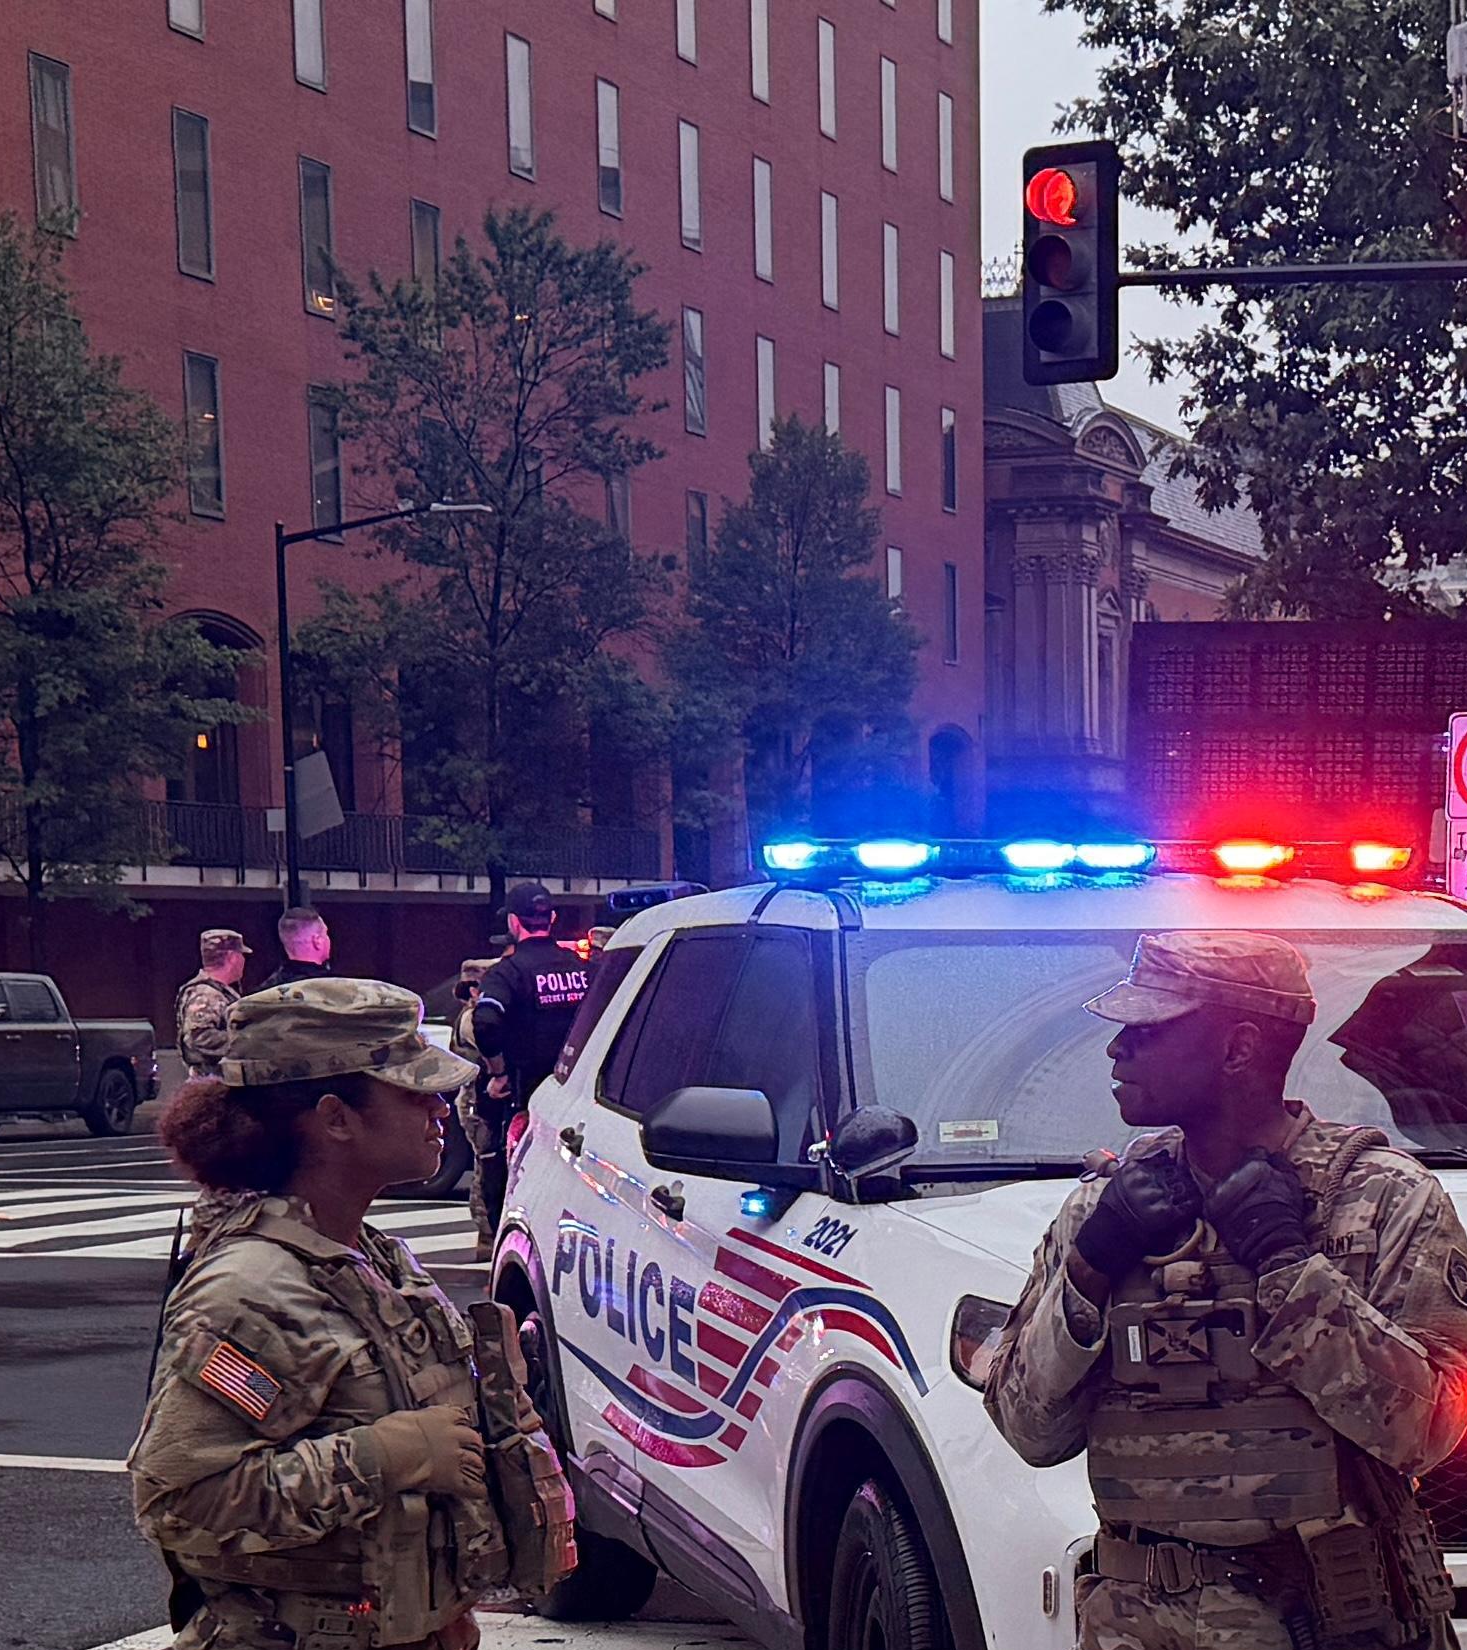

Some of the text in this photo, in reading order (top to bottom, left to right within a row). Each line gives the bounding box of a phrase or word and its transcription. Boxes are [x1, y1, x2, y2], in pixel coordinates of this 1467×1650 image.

[536, 971, 589, 993] POLICE
[802, 1215, 859, 1258] 2021
[552, 1209, 698, 1386] POLICE
